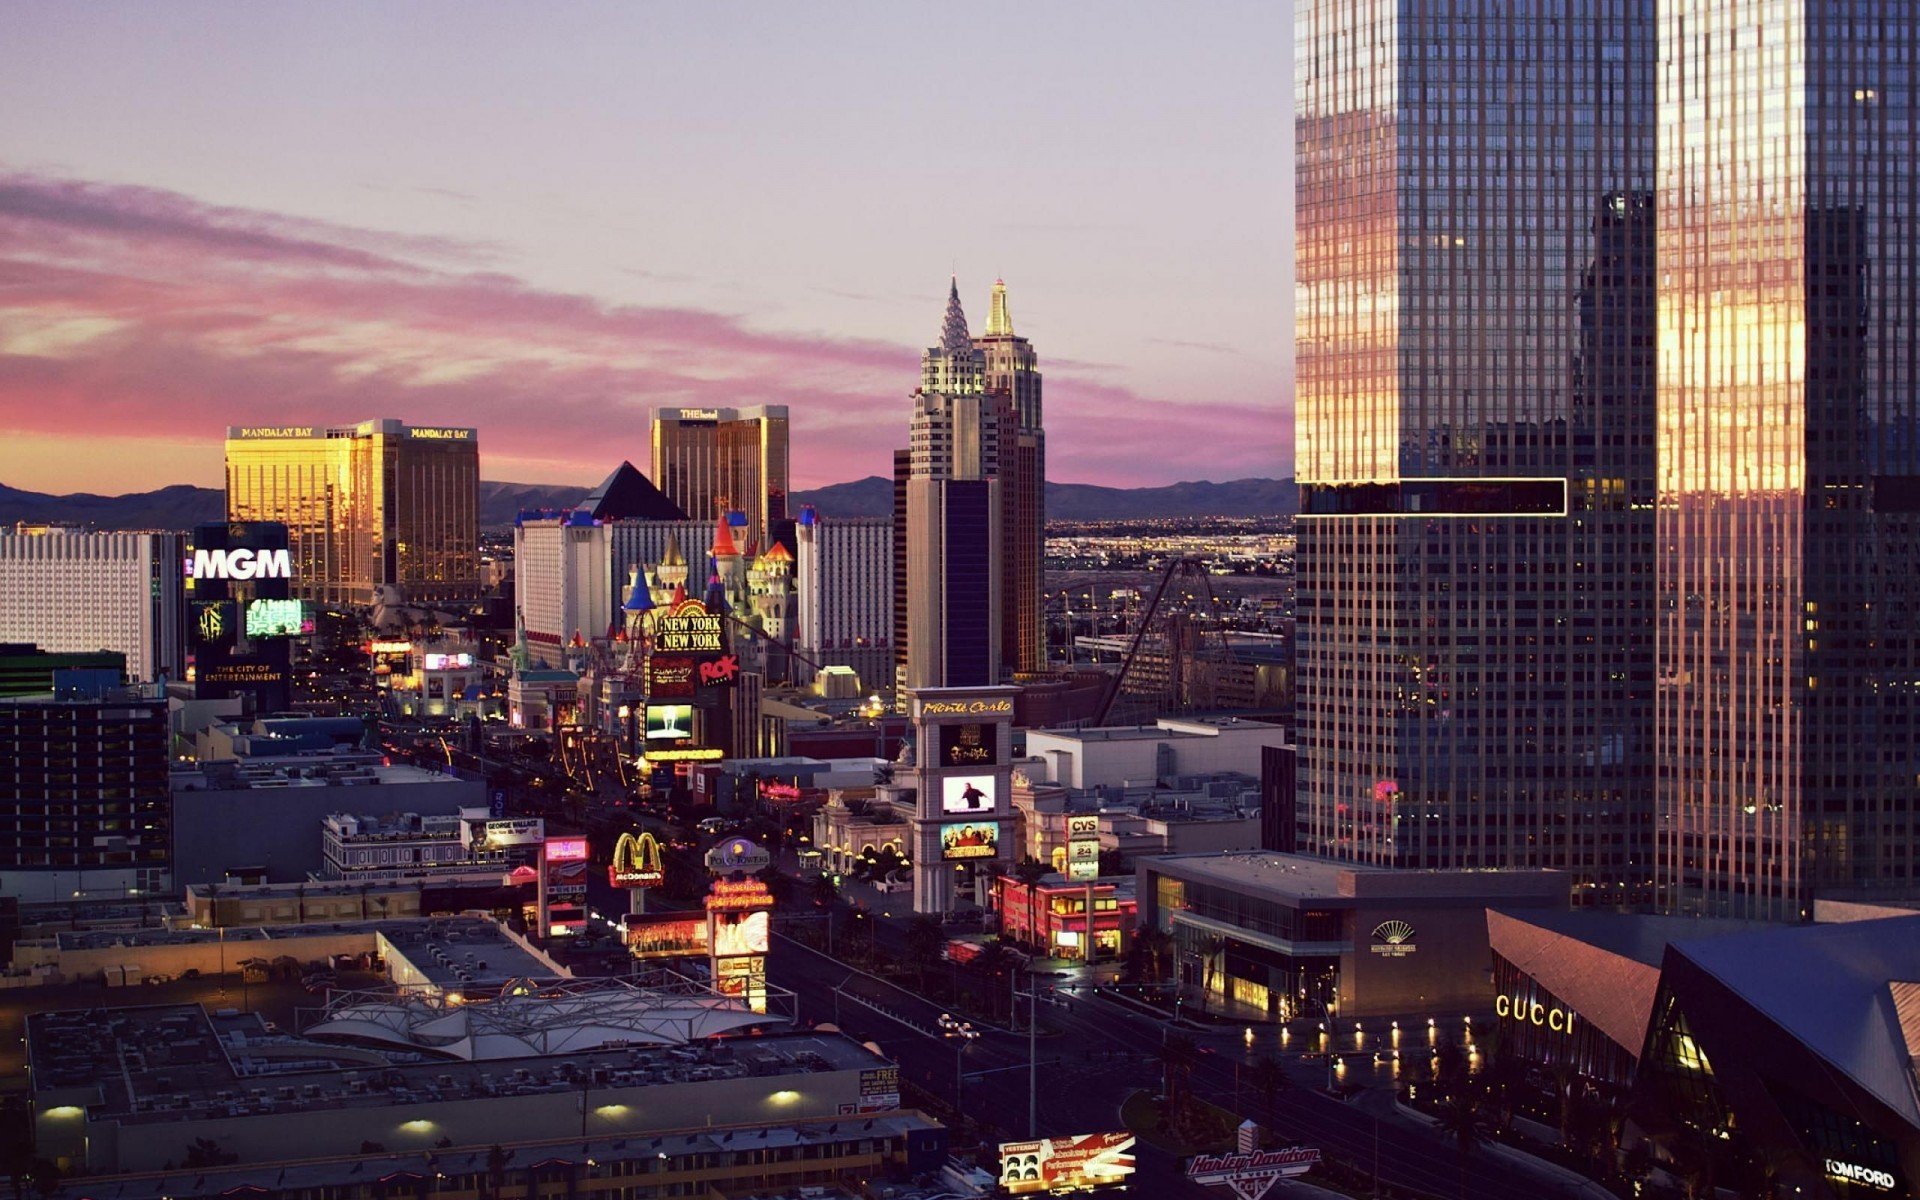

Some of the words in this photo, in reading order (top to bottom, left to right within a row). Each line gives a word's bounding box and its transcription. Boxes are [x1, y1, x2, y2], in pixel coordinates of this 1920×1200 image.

[241, 427, 293, 438] MANDALAY
[294, 427, 313, 437] BAY
[411, 428, 453, 439] MANDALAY
[454, 429, 468, 439] BAY
[193, 548, 291, 580] MGM
[664, 617, 689, 631] NEW
[691, 617, 721, 631] YORK
[664, 634, 689, 648] NEW
[691, 634, 721, 648] YORK
[216, 665, 234, 673] THE
[236, 665, 255, 673] CITY
[205, 673, 282, 682] ENTERTAINMENT
[922, 702, 967, 714] Monte
[969, 700, 1011, 714] Carlo
[488, 822, 511, 830] GEORGE
[1072, 820, 1096, 831] CVS
[1077, 847, 1092, 856] 24
[1496, 995, 1573, 1035] GUCCI
[876, 1069, 898, 1081] FREE
[1005, 1143, 1040, 1152] YESTERDAY
[1187, 1147, 1321, 1175] Harley-Davidson
[1248, 1169, 1283, 1177] VEGAS
[1825, 1159, 1854, 1178] TOM
[1853, 1165, 1895, 1188] FORD
